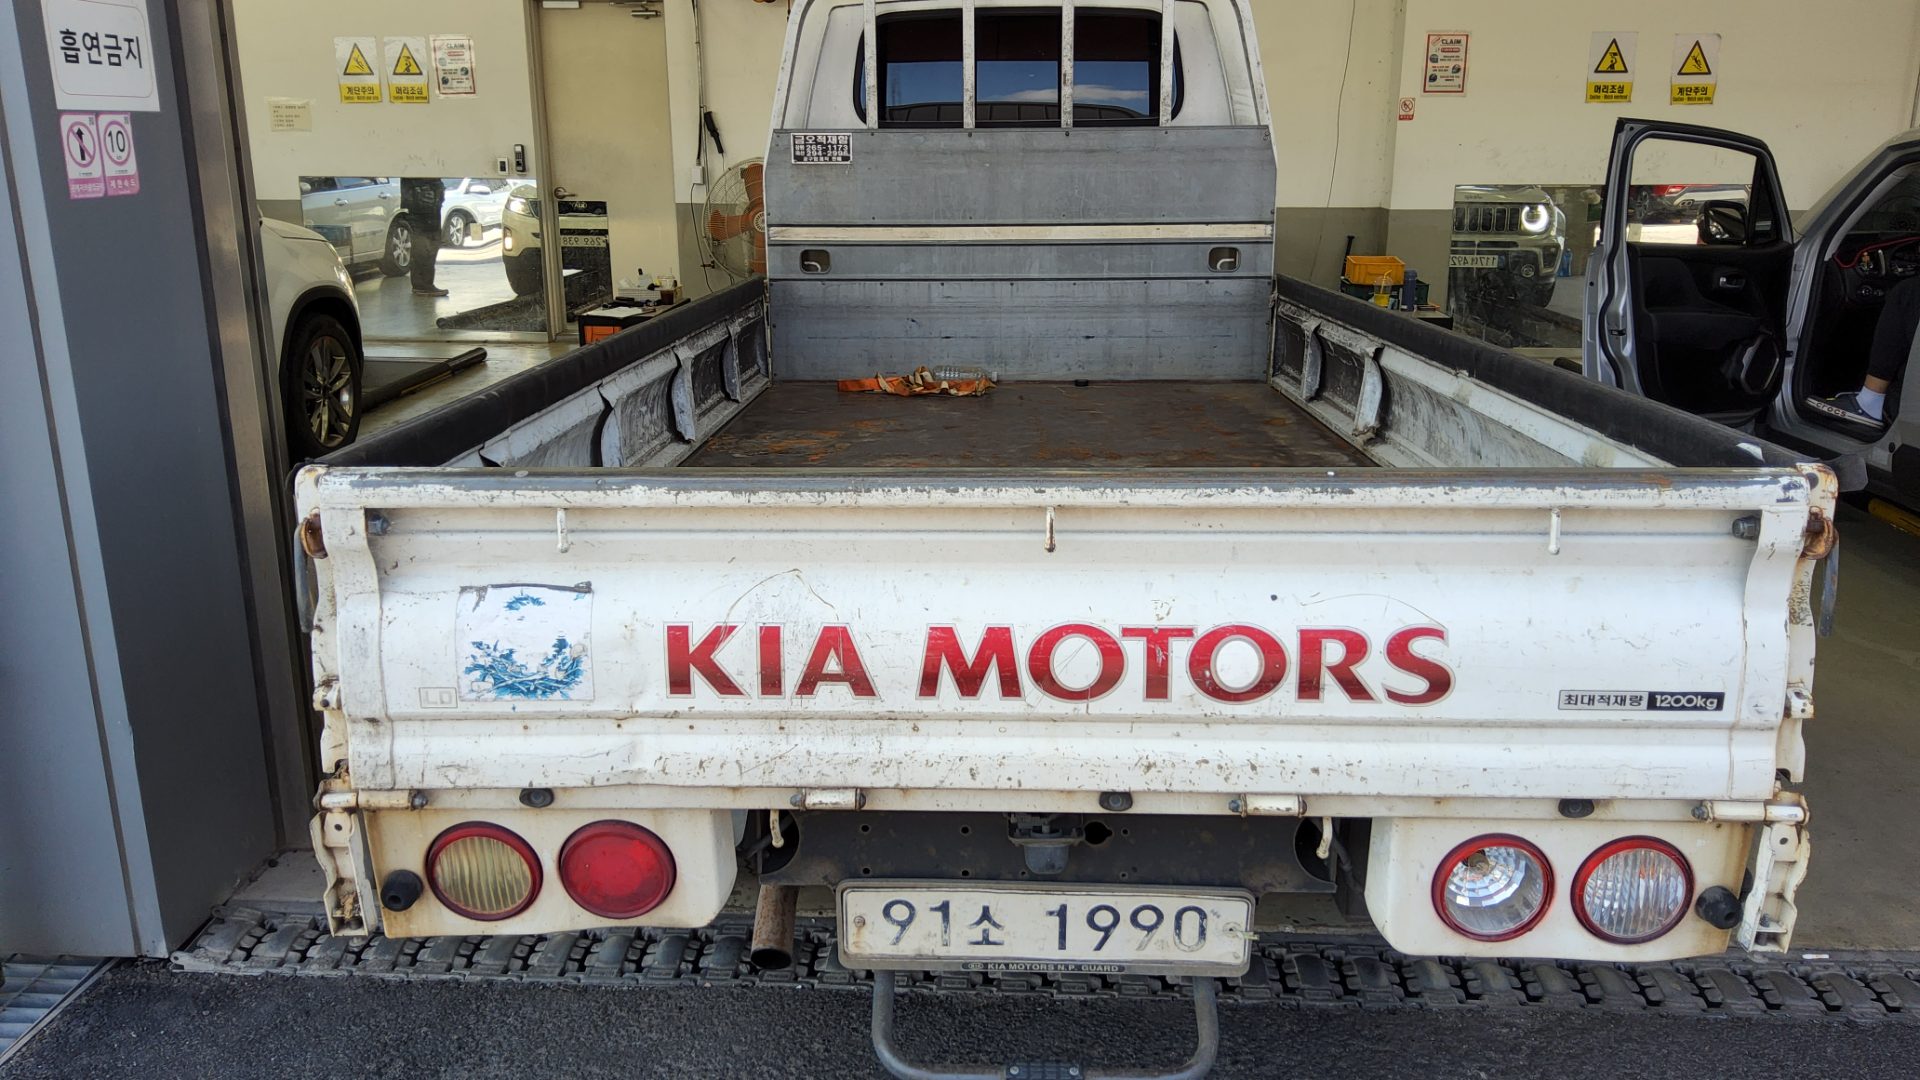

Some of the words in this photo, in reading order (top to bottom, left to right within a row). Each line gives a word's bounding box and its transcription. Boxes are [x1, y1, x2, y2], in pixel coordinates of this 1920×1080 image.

[59, 28, 142, 69] 흡연금지
[346, 86, 375, 95] 계단주의
[1594, 84, 1625, 94] 머리조심
[1677, 86, 1708, 96] 계단주의
[108, 130, 126, 153] 10
[1816, 402, 1847, 417] crocs
[663, 621, 881, 700] KIA
[915, 621, 1456, 707] MOTORS
[1563, 693, 1644, 707] 최대적재량
[1654, 694, 1718, 710] 1200kg
[881, 898, 1005, 948] 91소
[1045, 903, 1209, 953] 1990
[987, 962, 1007, 971] KIA
[1008, 962, 1055, 972] MOTORS
[1081, 963, 1119, 973] GUARD
